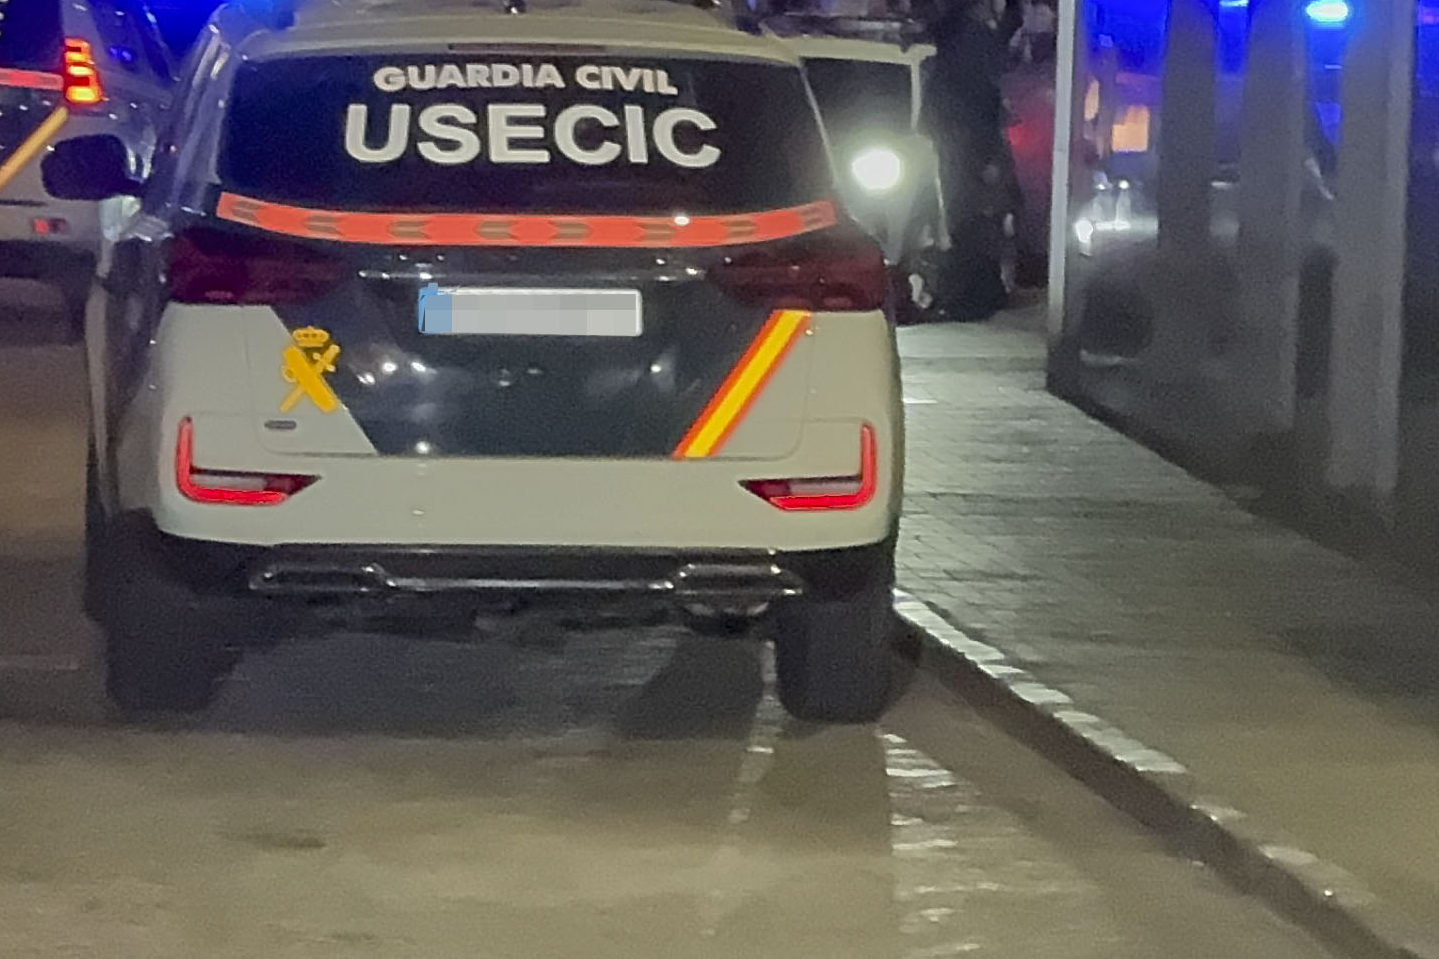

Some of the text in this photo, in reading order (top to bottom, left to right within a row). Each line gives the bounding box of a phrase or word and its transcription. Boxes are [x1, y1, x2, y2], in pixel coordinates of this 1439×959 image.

[374, 63, 678, 95] GUARDIA CIVIL
[345, 104, 722, 168] USECIC
